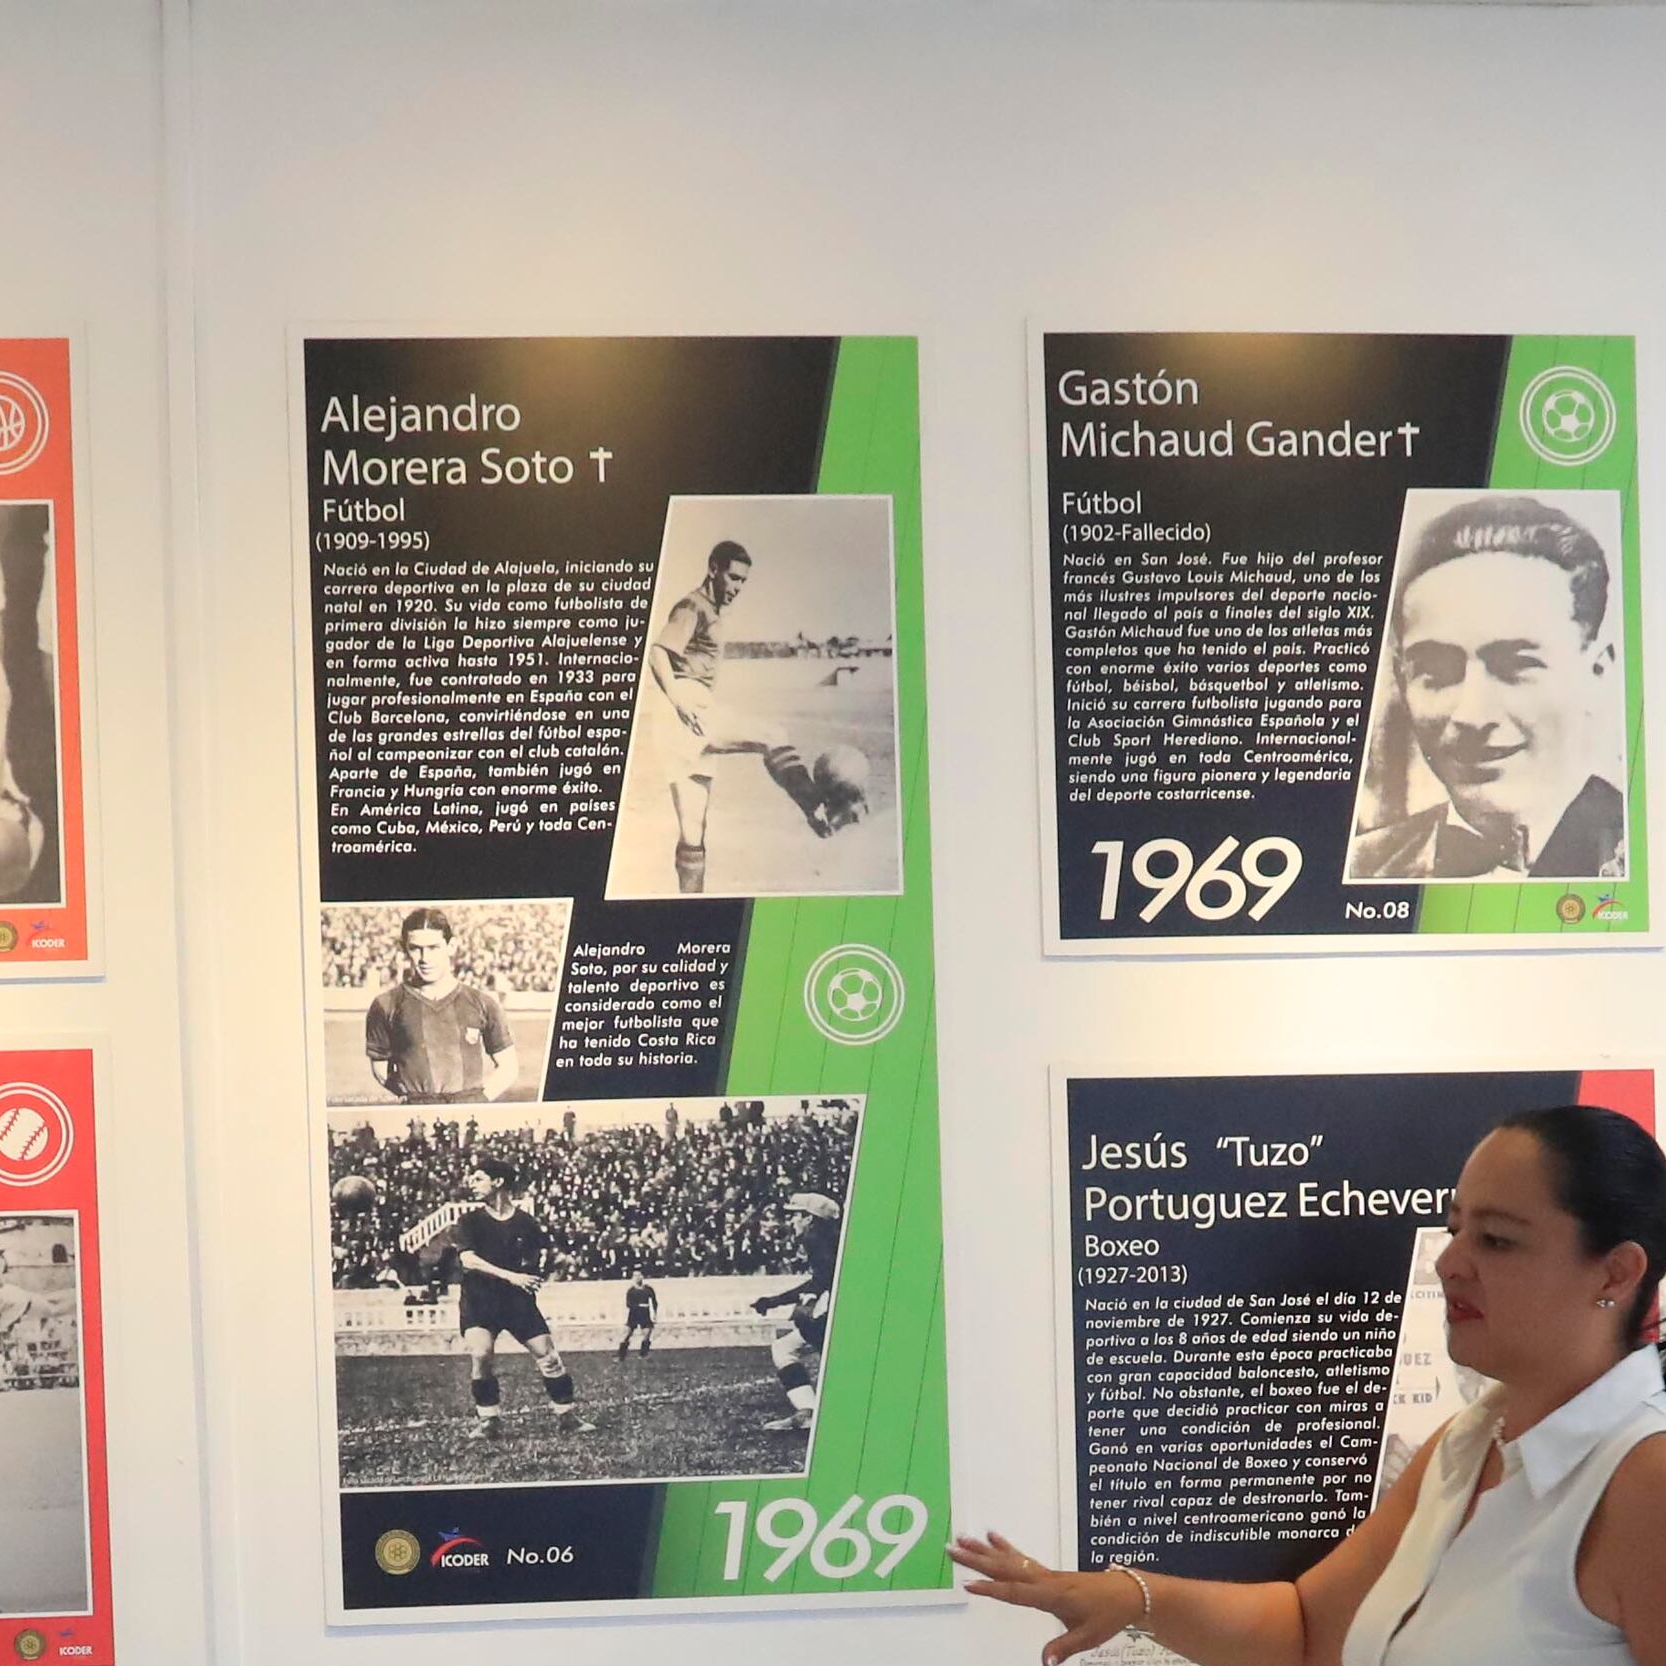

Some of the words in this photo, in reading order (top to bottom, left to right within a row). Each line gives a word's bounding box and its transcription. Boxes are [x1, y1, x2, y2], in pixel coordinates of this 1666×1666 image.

[1059, 369, 1198, 405] Gastón
[321, 394, 521, 442] Alejandro
[1062, 420, 1233, 457] Michaud
[1247, 420, 1392, 457] Gander
[324, 450, 466, 485] Morera
[481, 448, 574, 484] Soto
[324, 498, 404, 522] Fútbol
[1063, 491, 1141, 514] Fútbol
[315, 531, 431, 553] (1909-1995)
[1063, 523, 1211, 544] (1902-Fallecido)
[1092, 836, 1302, 923] 1969
[1345, 902, 1409, 919] No.08
[556, 1058, 574, 1068] en
[580, 1053, 612, 1067] toda
[618, 1056, 633, 1066] su
[639, 1052, 697, 1065] historia.
[1083, 1133, 1187, 1170] Jesús
[1086, 1187, 1287, 1229] Portuguez
[1085, 1235, 1159, 1257] Boxeo
[1077, 1265, 1188, 1288] (1927-2013)
[715, 1494, 928, 1582] 1969
[440, 1552, 489, 1567] ICODER
[507, 1546, 573, 1564] No.06
[1091, 1551, 1104, 1563] la
[1110, 1550, 1159, 1566] región.
